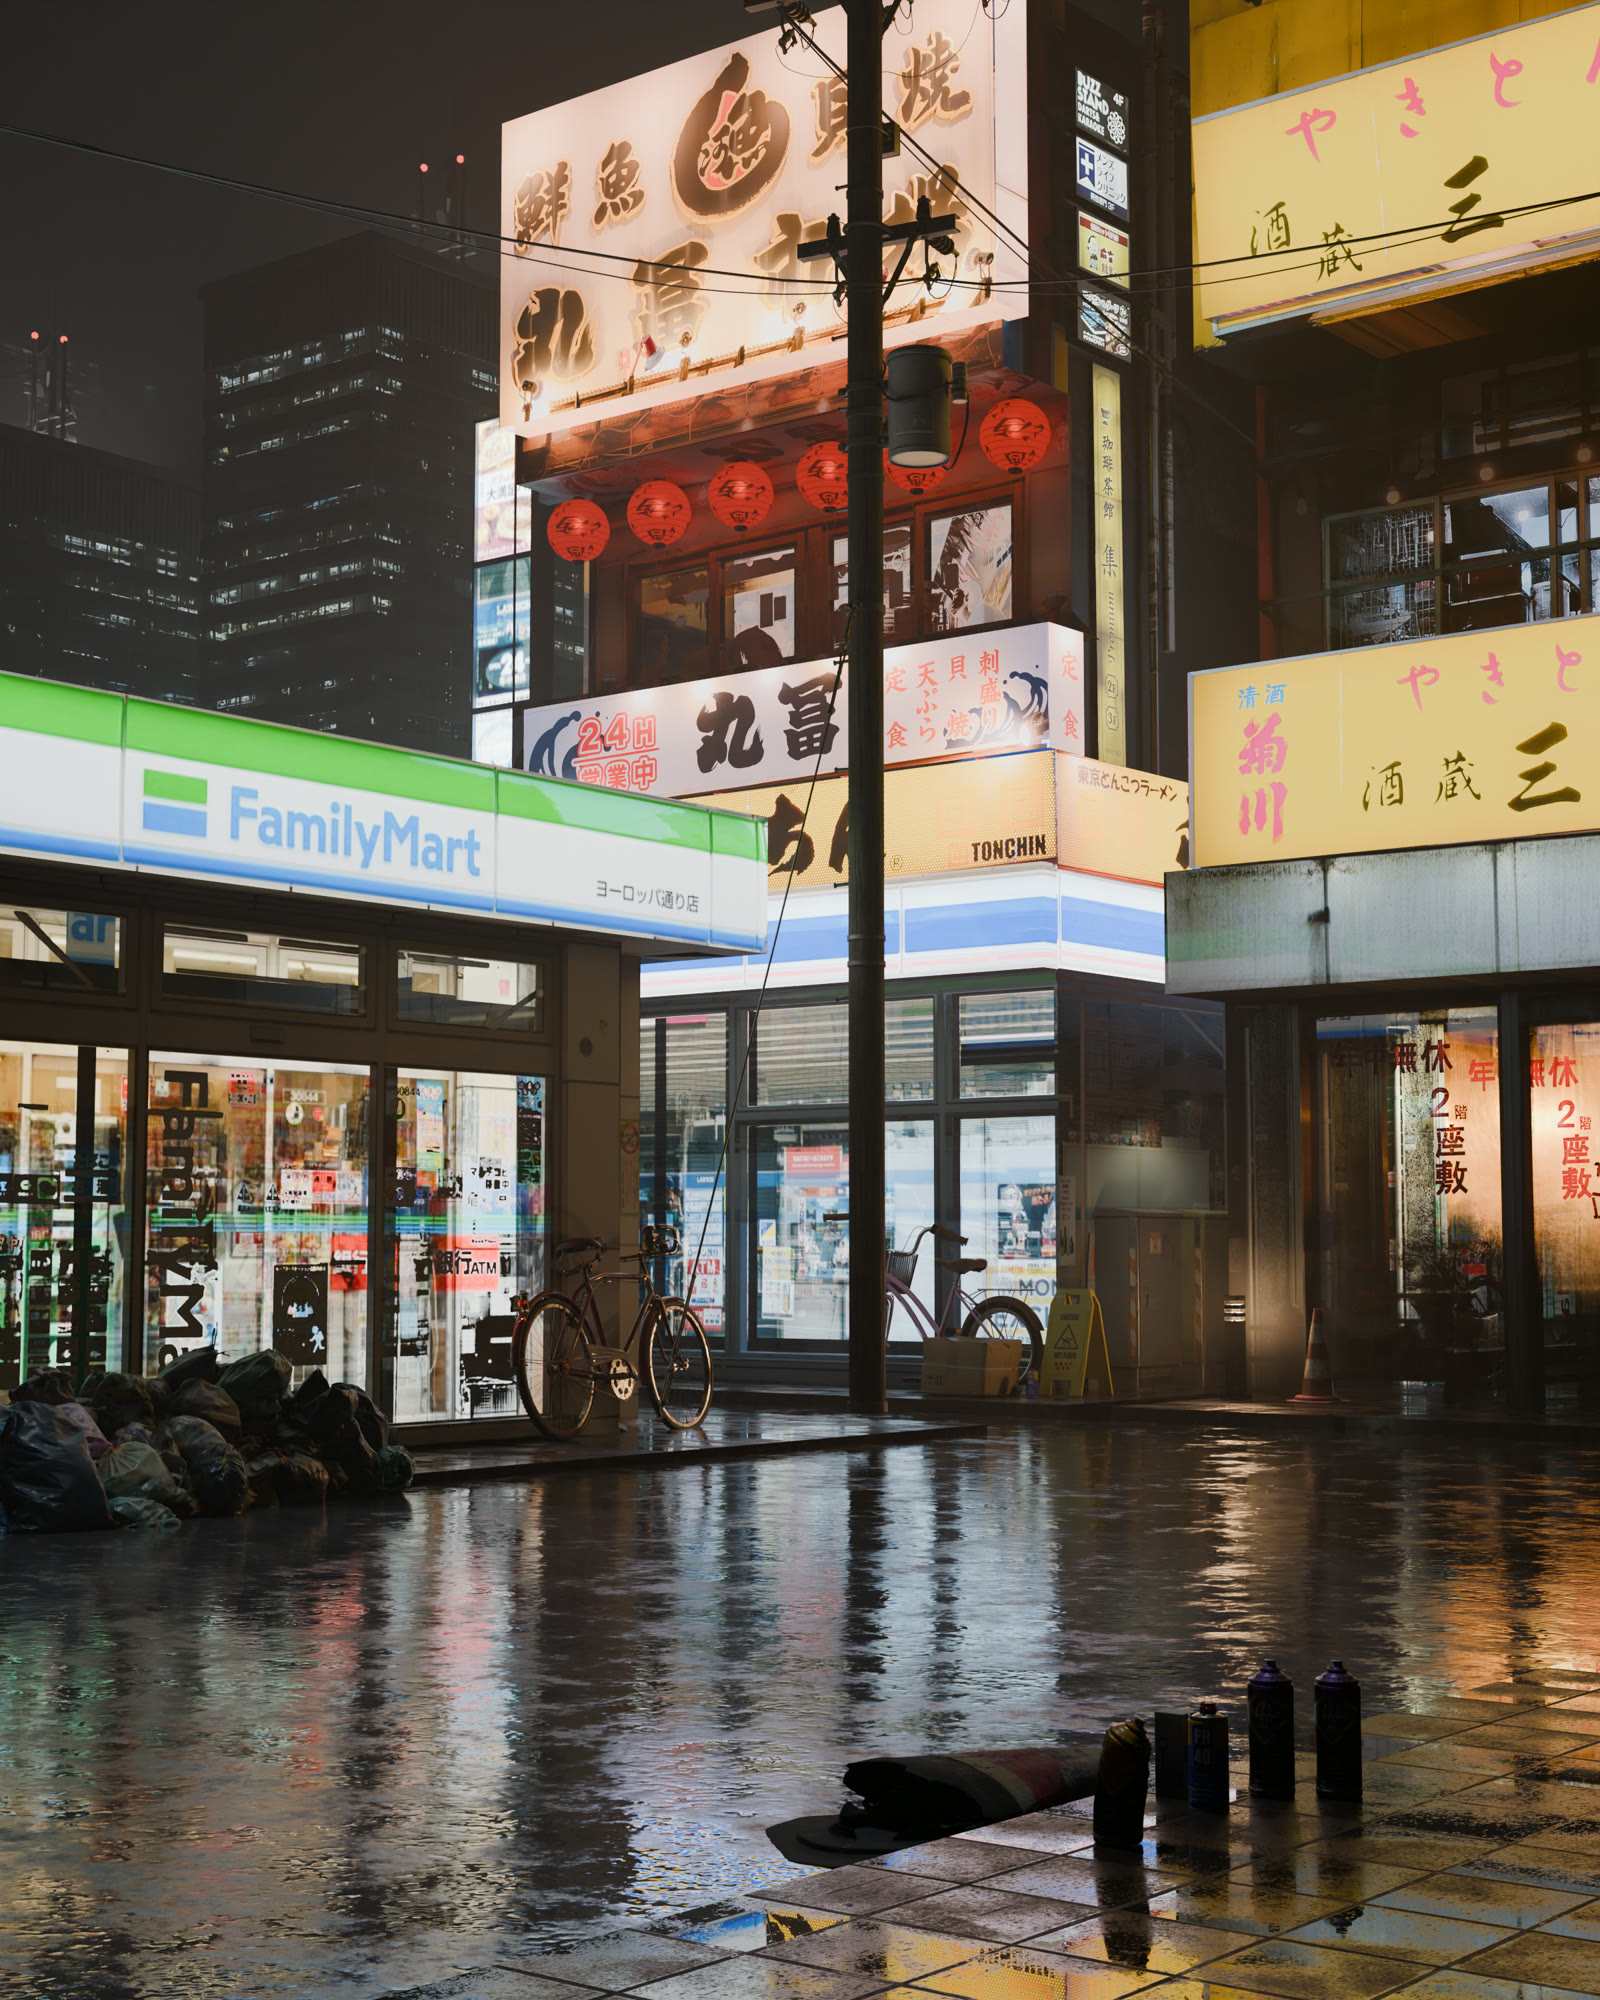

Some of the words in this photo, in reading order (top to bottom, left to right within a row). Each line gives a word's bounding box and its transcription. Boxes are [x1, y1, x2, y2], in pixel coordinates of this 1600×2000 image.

[1077, 86, 1109, 115] STAND
[1113, 93, 1124, 107] 4F
[1077, 112, 1105, 136] KARAOKE
[885, 667, 908, 749] 定食
[916, 661, 939, 744] 天ぷら
[1061, 651, 1080, 740] 定食
[1238, 683, 1288, 709] 清酒
[577, 712, 656, 757] 24H
[1077, 764, 1178, 802] 東京とんこつラーメン
[1238, 712, 1288, 844] 菊川
[230, 785, 481, 877] FamilyMart
[971, 833, 1046, 863] TONCHIN
[597, 880, 699, 913] ヨーロッパ通り店
[1468, 1055, 1578, 1092] 年無休
[1435, 1124, 1468, 1195] 座敷
[1561, 1134, 1593, 1201] 座敷
[692, 1260, 716, 1274] ATM
